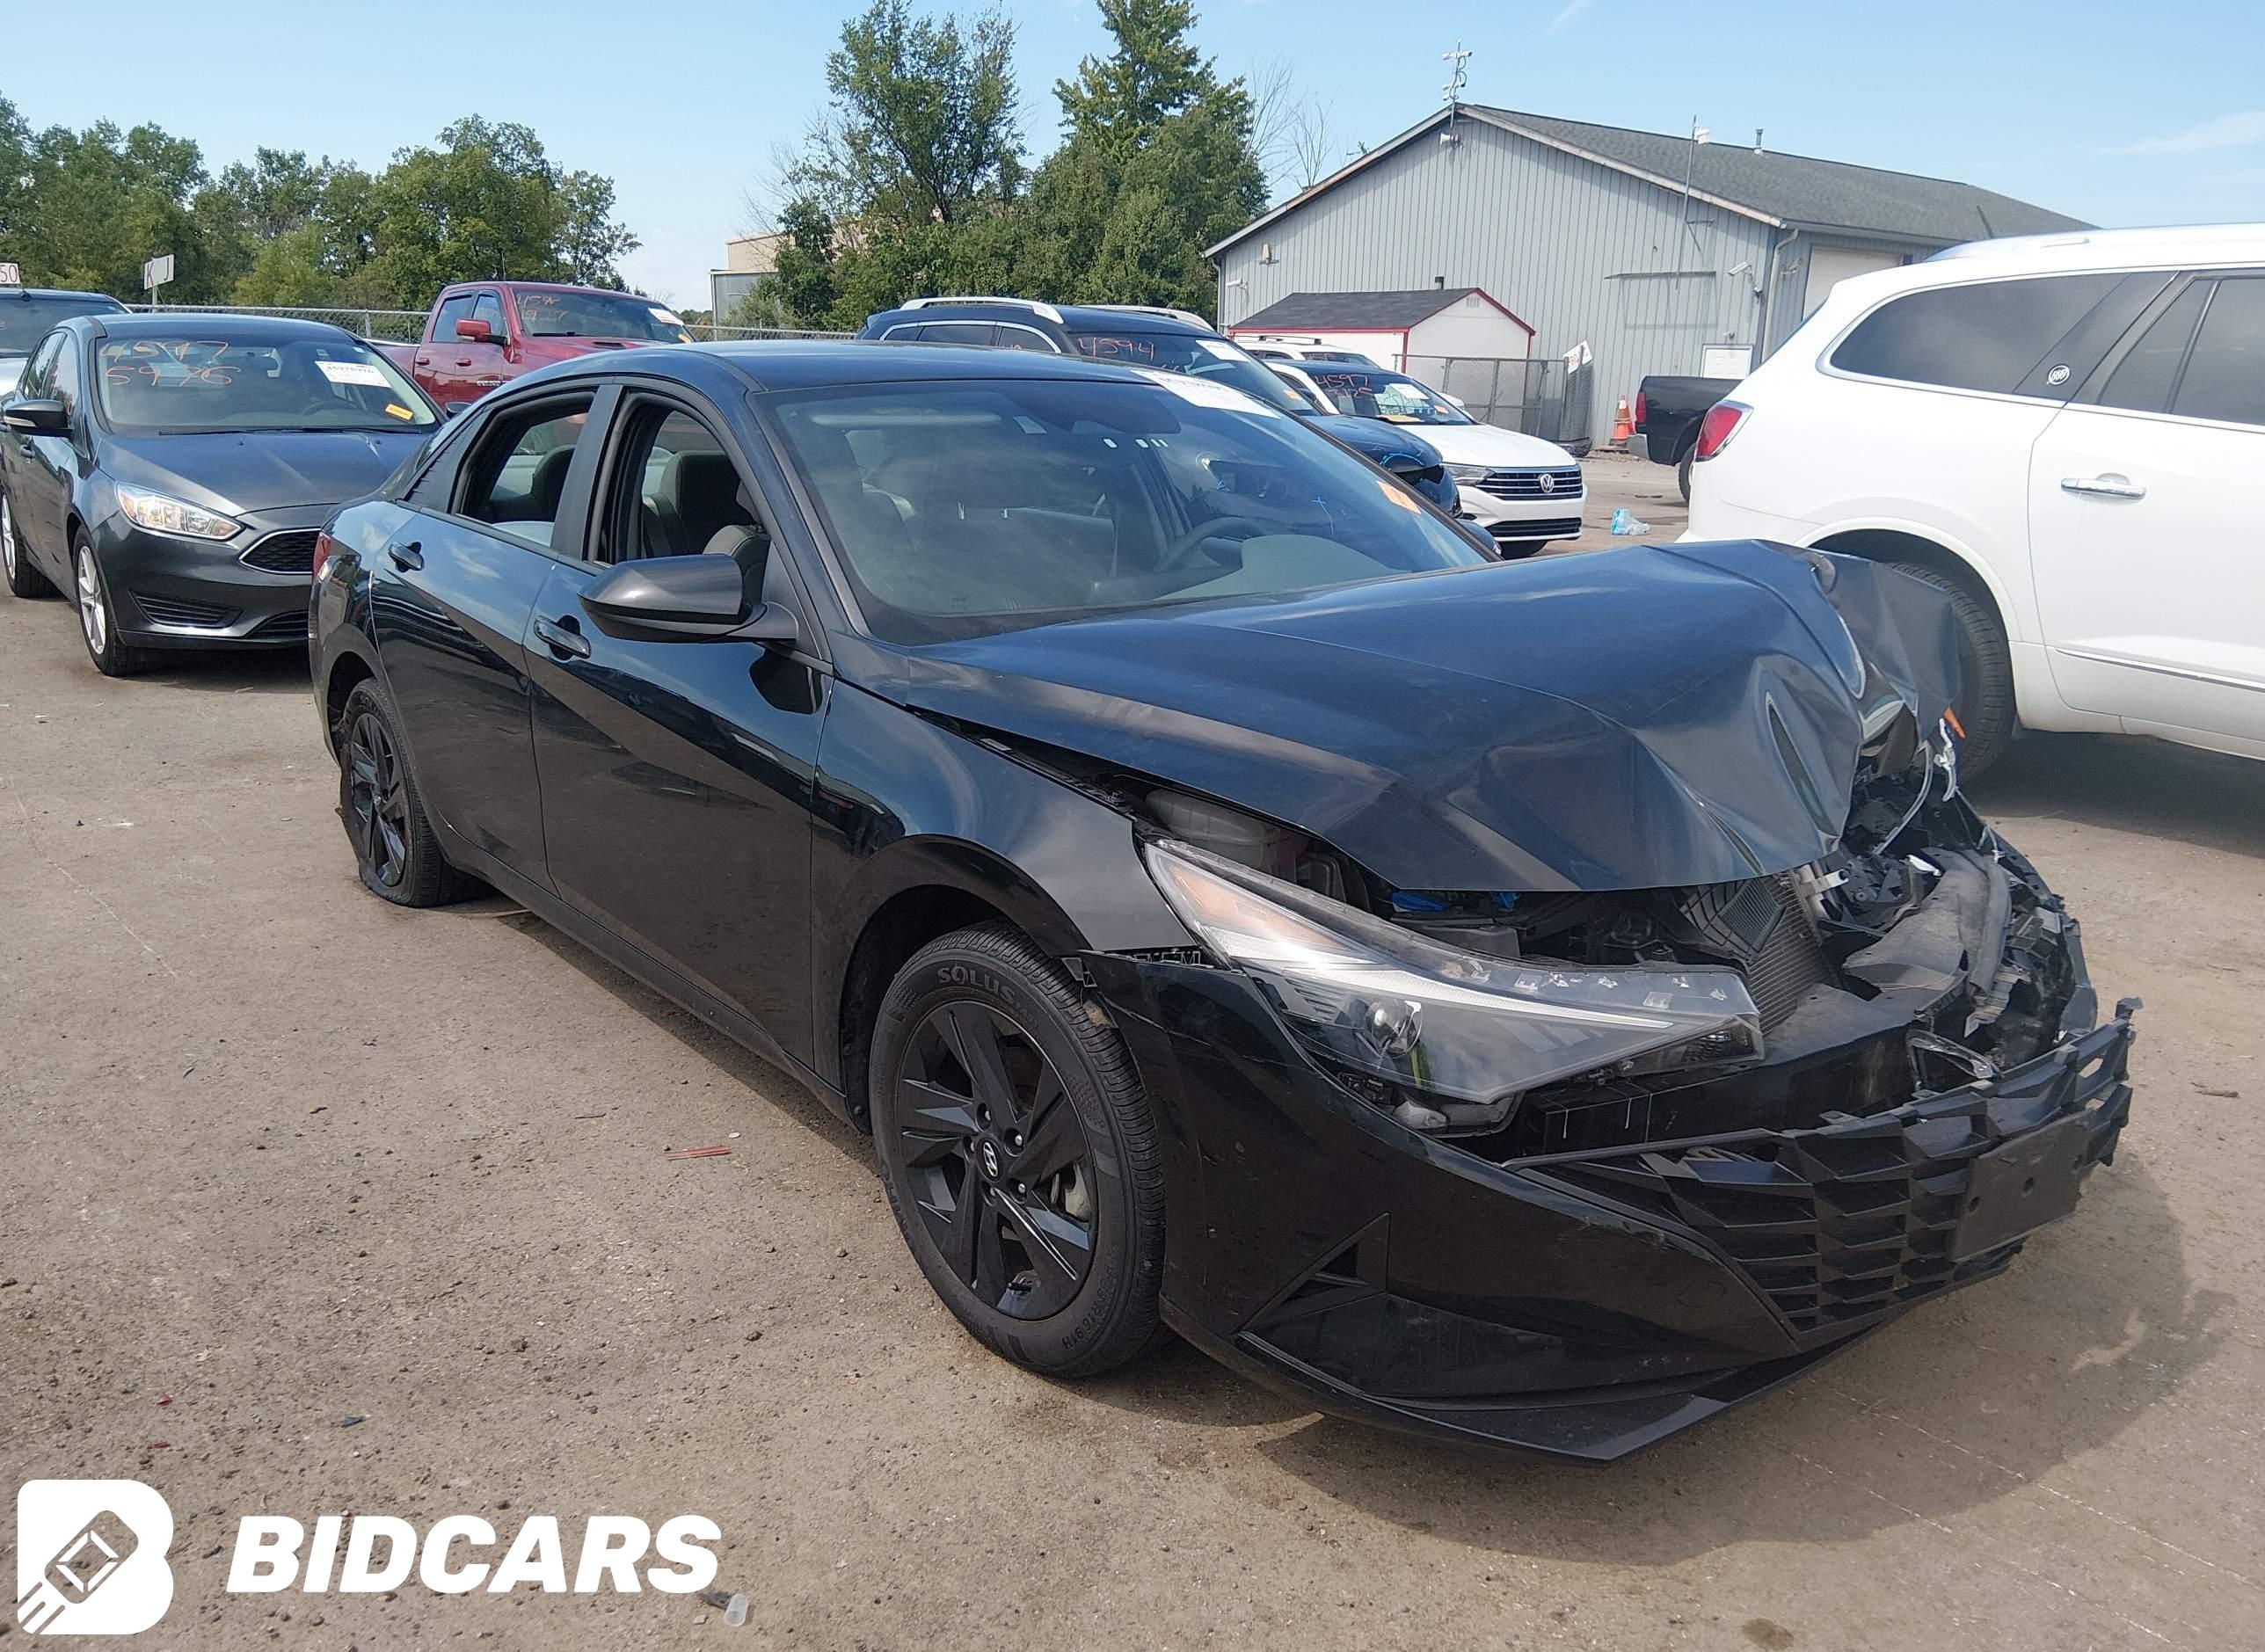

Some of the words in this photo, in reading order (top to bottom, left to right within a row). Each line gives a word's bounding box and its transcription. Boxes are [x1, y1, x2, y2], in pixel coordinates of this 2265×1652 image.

[146, 261, 154, 287] K
[1077, 337, 1155, 362] 4594
[1314, 374, 1369, 389] 4597
[936, 965, 1016, 1004] SOLUS
